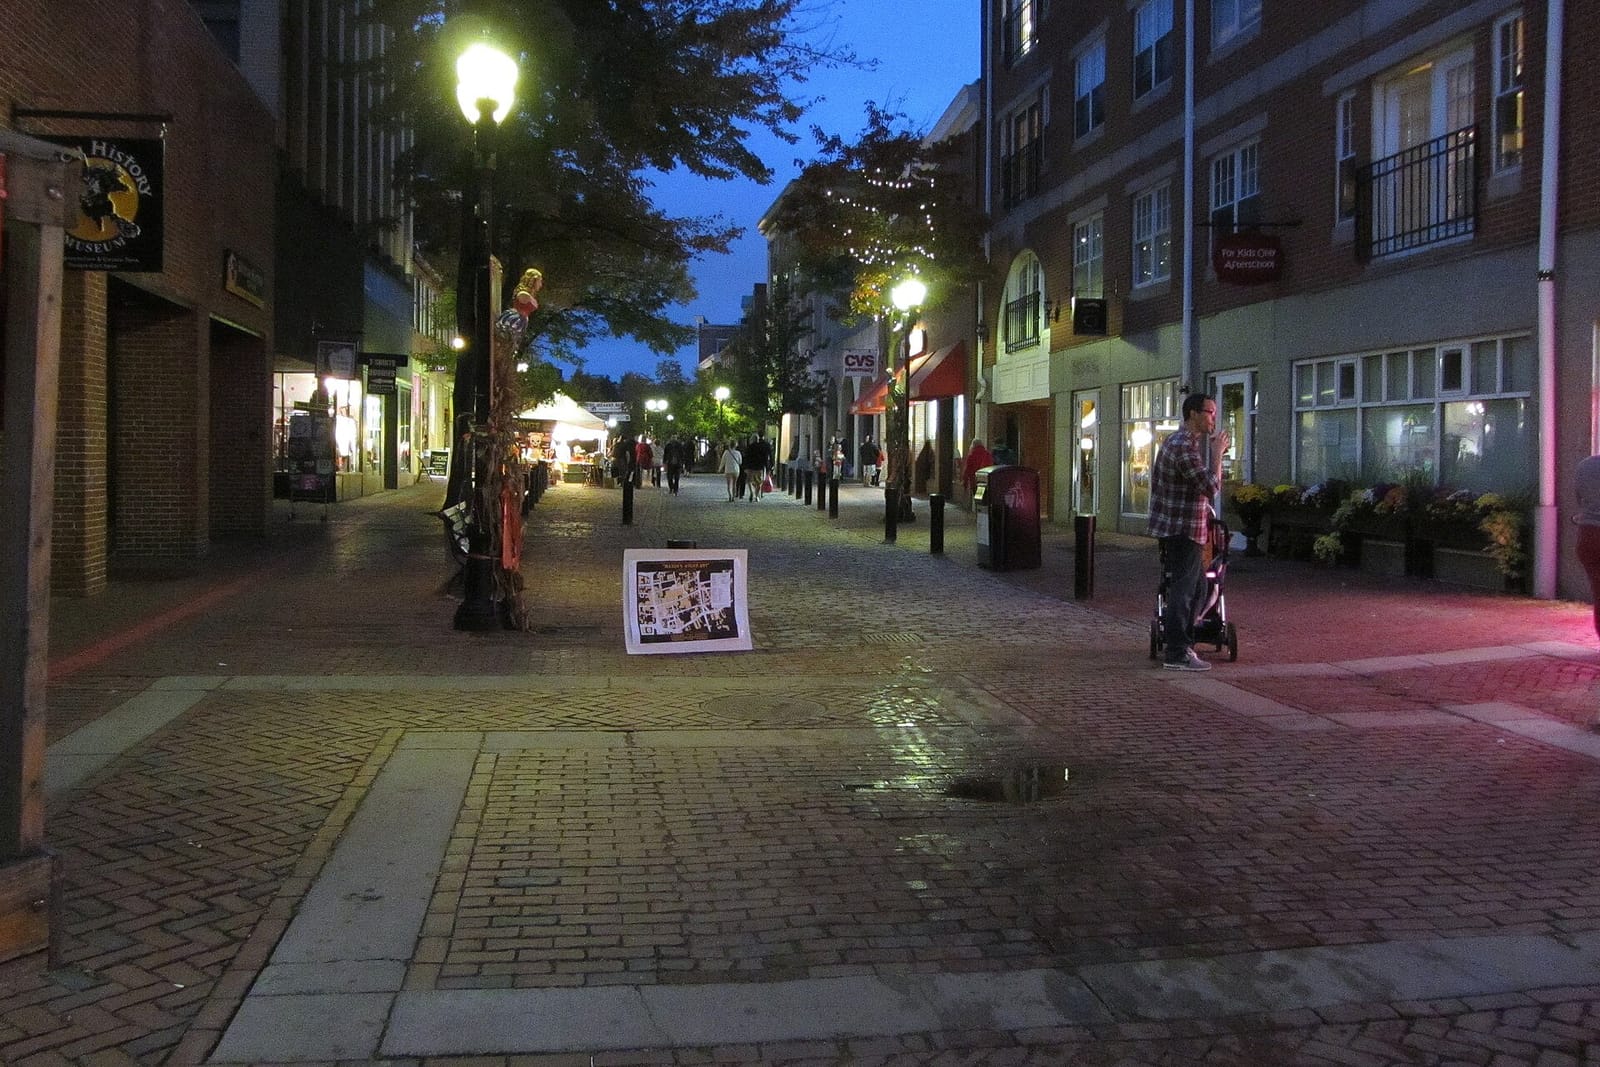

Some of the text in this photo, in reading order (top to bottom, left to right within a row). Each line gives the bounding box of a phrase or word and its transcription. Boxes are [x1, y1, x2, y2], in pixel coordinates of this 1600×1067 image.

[64, 234, 126, 254] MUSEUM
[1236, 247, 1256, 258] Kids
[844, 354, 875, 367] CVS
